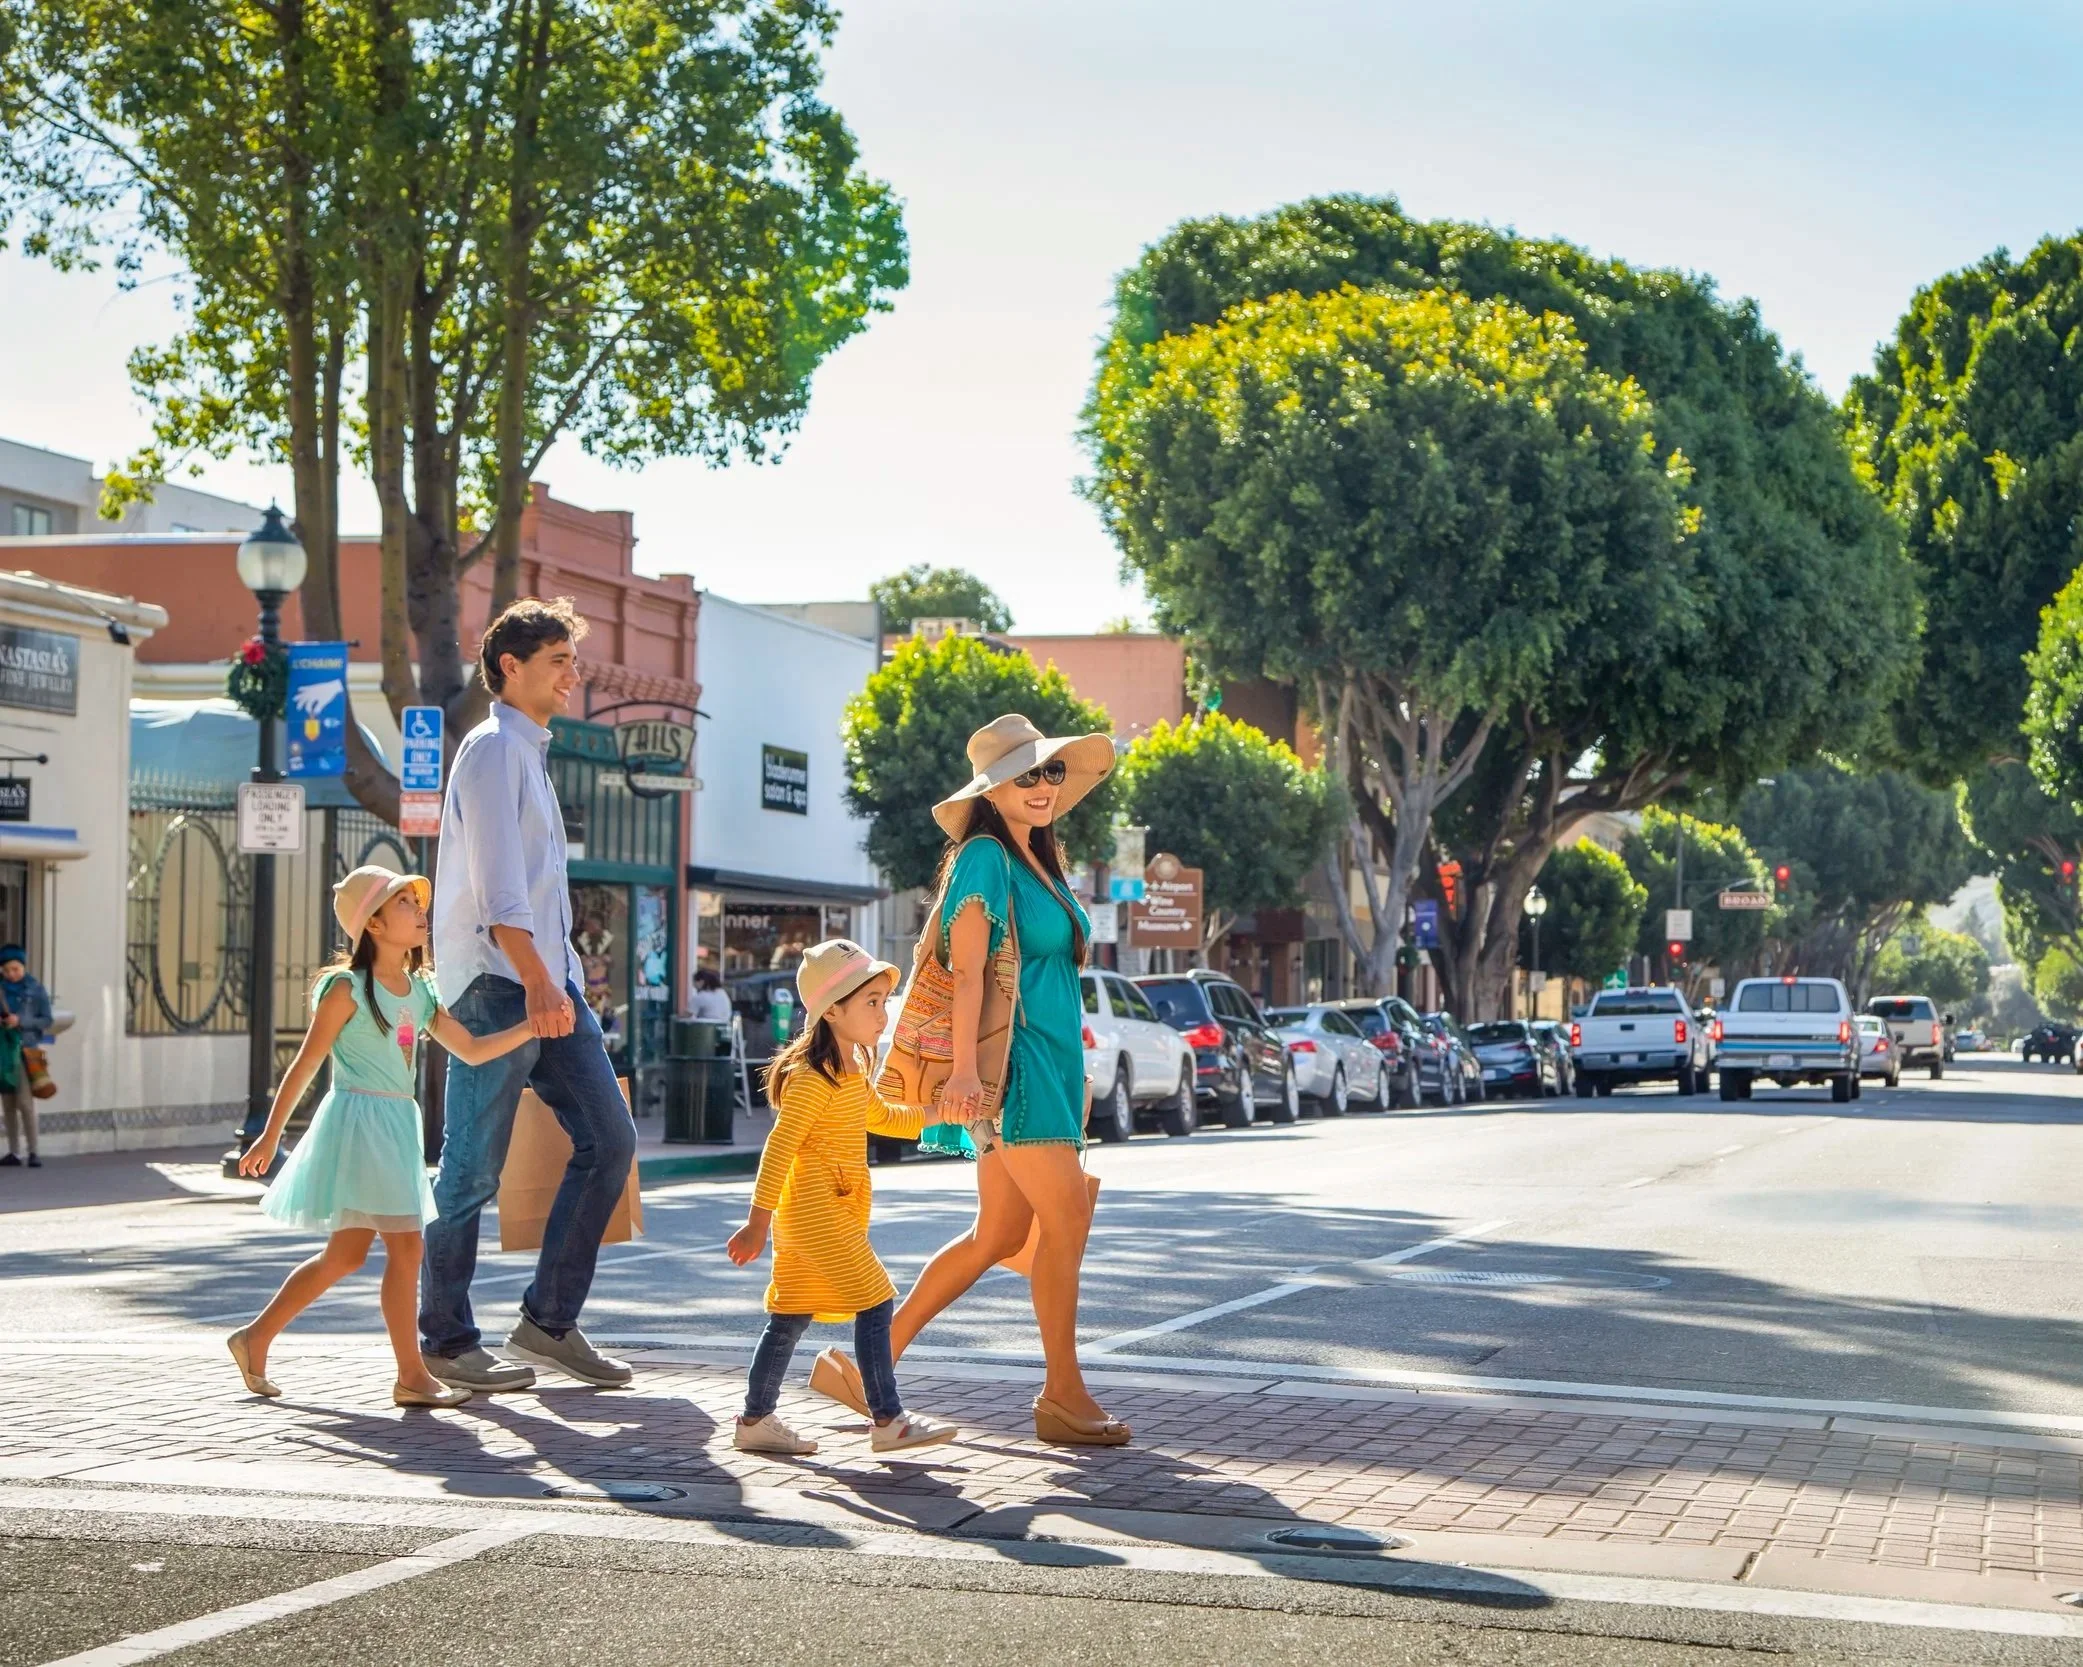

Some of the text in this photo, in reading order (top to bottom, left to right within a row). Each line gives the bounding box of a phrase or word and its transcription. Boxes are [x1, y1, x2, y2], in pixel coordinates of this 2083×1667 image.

[621, 723, 682, 762] TAILS
[244, 788, 298, 800] PASSENGER
[251, 801, 291, 812] LOADING
[258, 813, 284, 823] ONLY
[1160, 881, 1193, 893] Airport
[1148, 905, 1187, 918] Country
